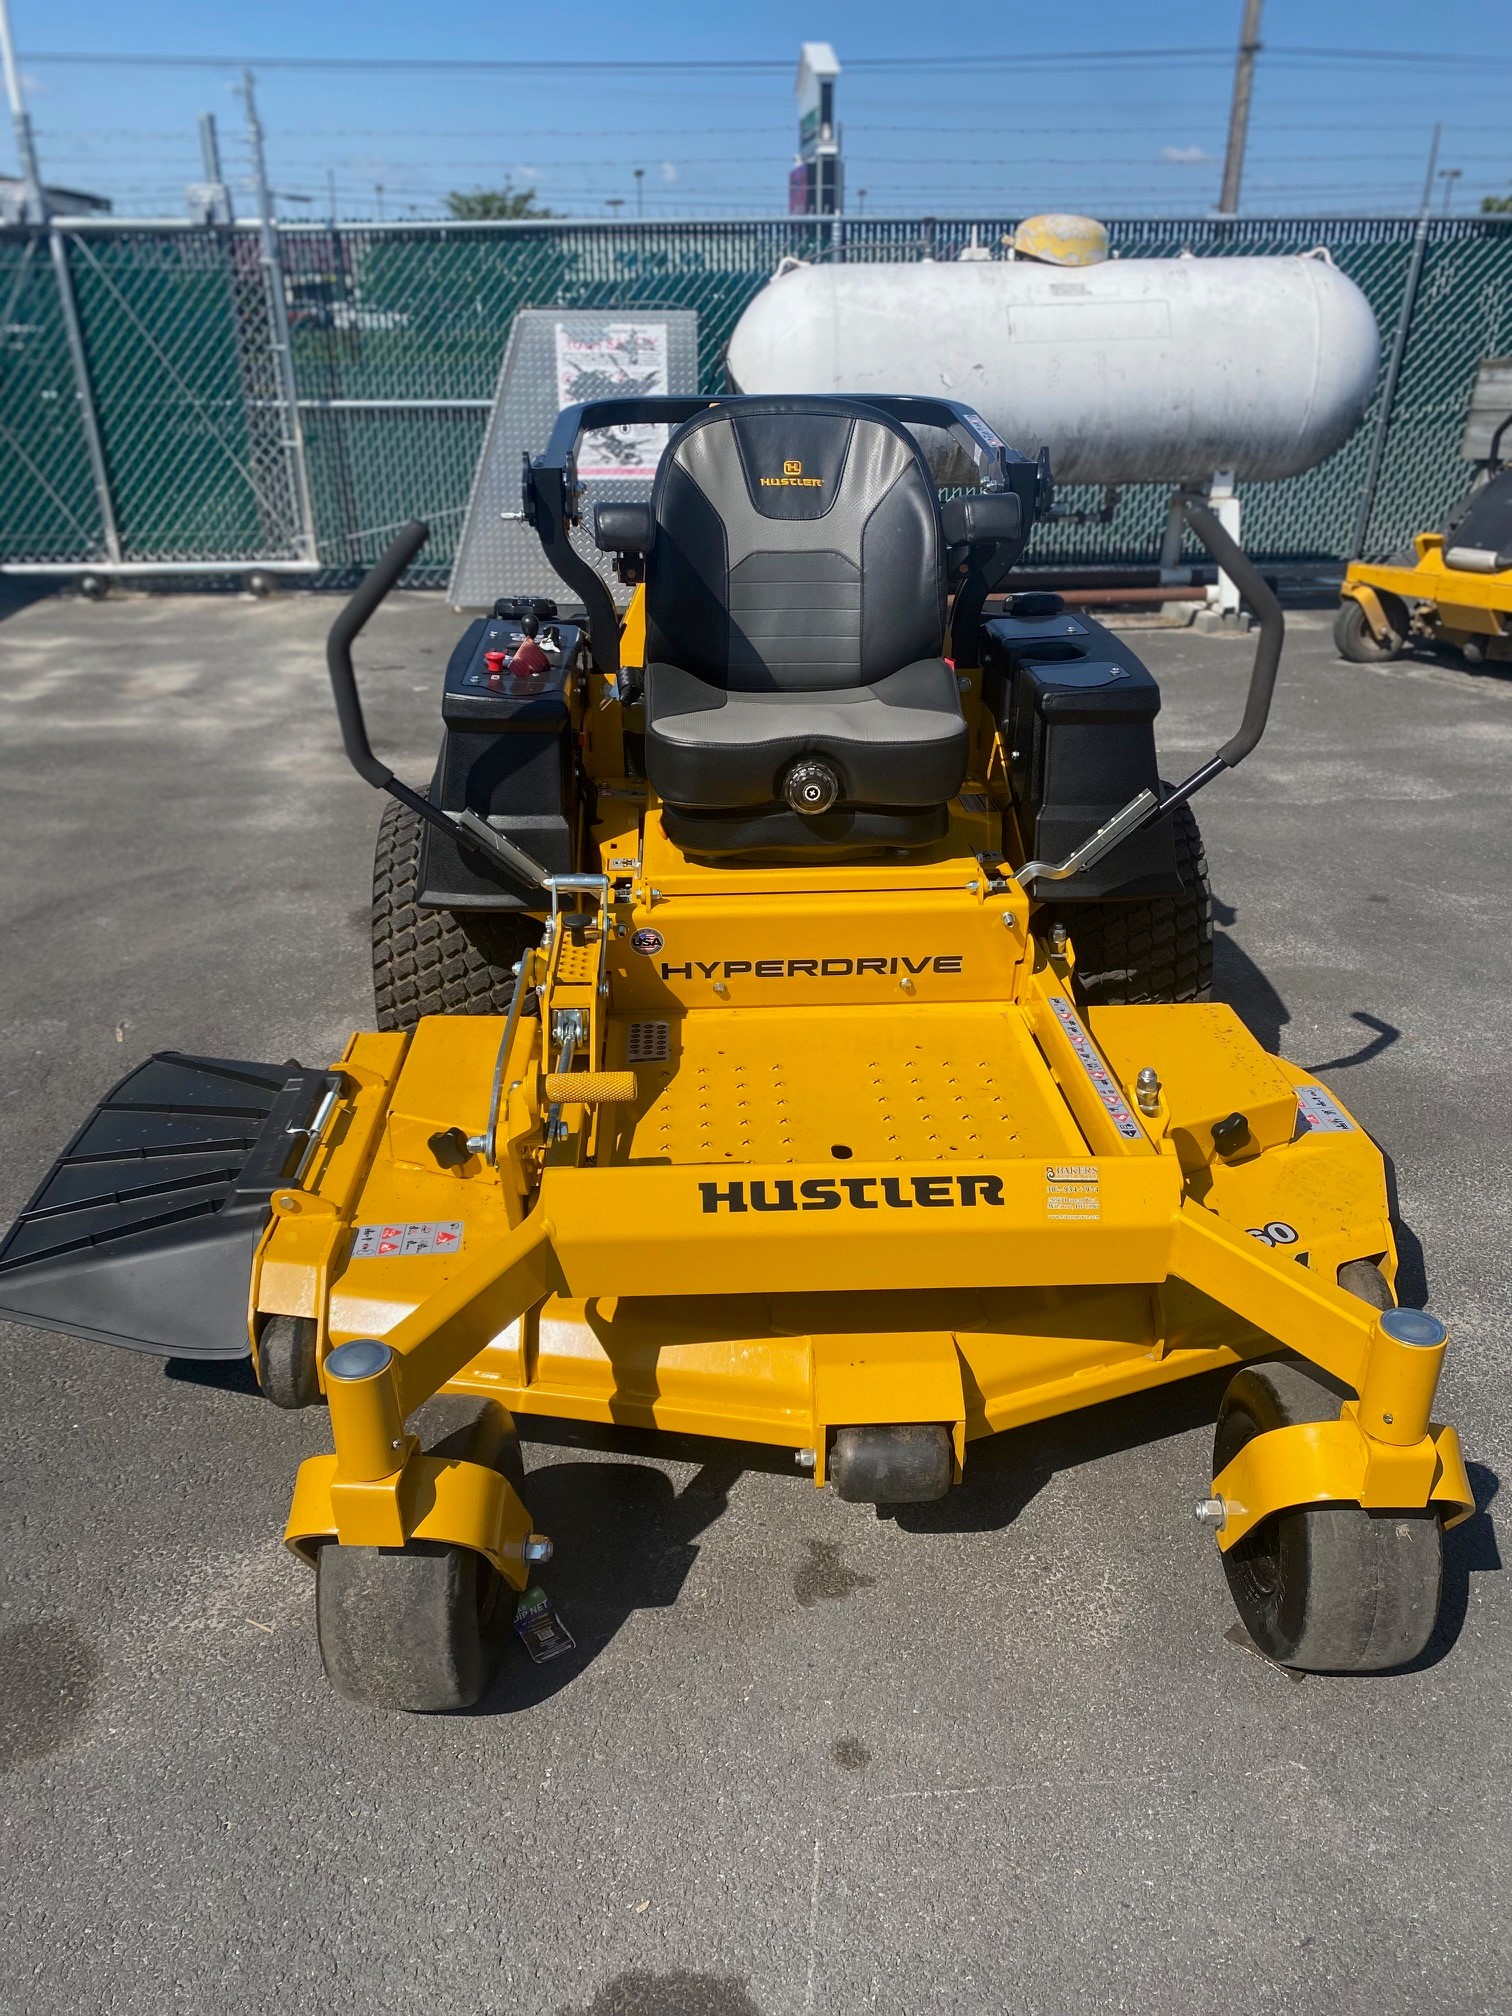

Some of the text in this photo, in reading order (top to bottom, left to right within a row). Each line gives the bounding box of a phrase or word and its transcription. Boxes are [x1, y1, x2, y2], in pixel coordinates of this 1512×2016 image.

[760, 478, 822, 487] HUSTLER
[632, 937, 662, 946] USA
[661, 956, 963, 980] HYPERDRIVE
[698, 1175, 1004, 1213] HUSTLER
[529, 1599, 548, 1615] NET
